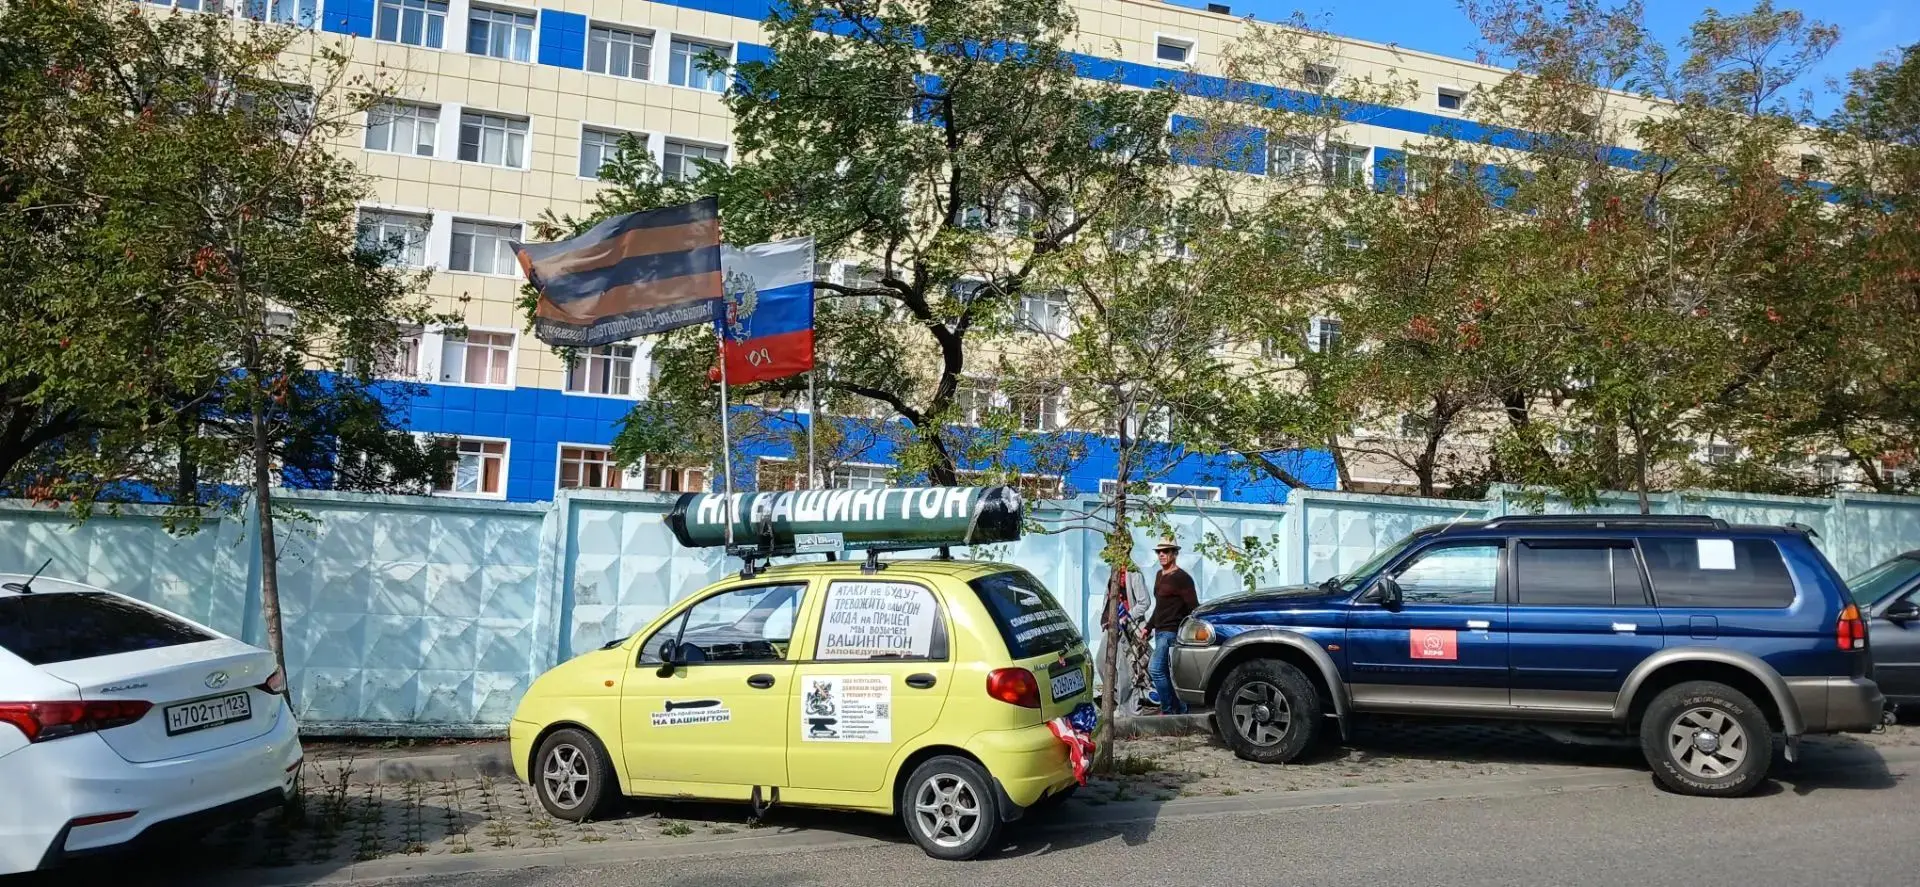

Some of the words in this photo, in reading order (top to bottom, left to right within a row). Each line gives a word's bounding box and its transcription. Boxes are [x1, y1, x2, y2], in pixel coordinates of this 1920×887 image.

[698, 493, 742, 524] НА
[751, 487, 972, 522] ВАШИНГТОН
[835, 584, 868, 596] АТАКИ
[885, 585, 919, 600] БУДУТ
[835, 598, 886, 610] ТРЕВОЖИТЬ
[902, 602, 920, 615] СОН
[830, 612, 857, 625] КОГДА
[873, 612, 910, 626] ПРИЦЕЛ
[849, 626, 865, 634] МЫ
[827, 634, 912, 649] ВАШИНГТОН
[173, 704, 223, 728] Н702ТТ
[226, 696, 245, 710] 123
[653, 718, 667, 726] НА
[670, 714, 730, 724] ВАШИНГТОН
